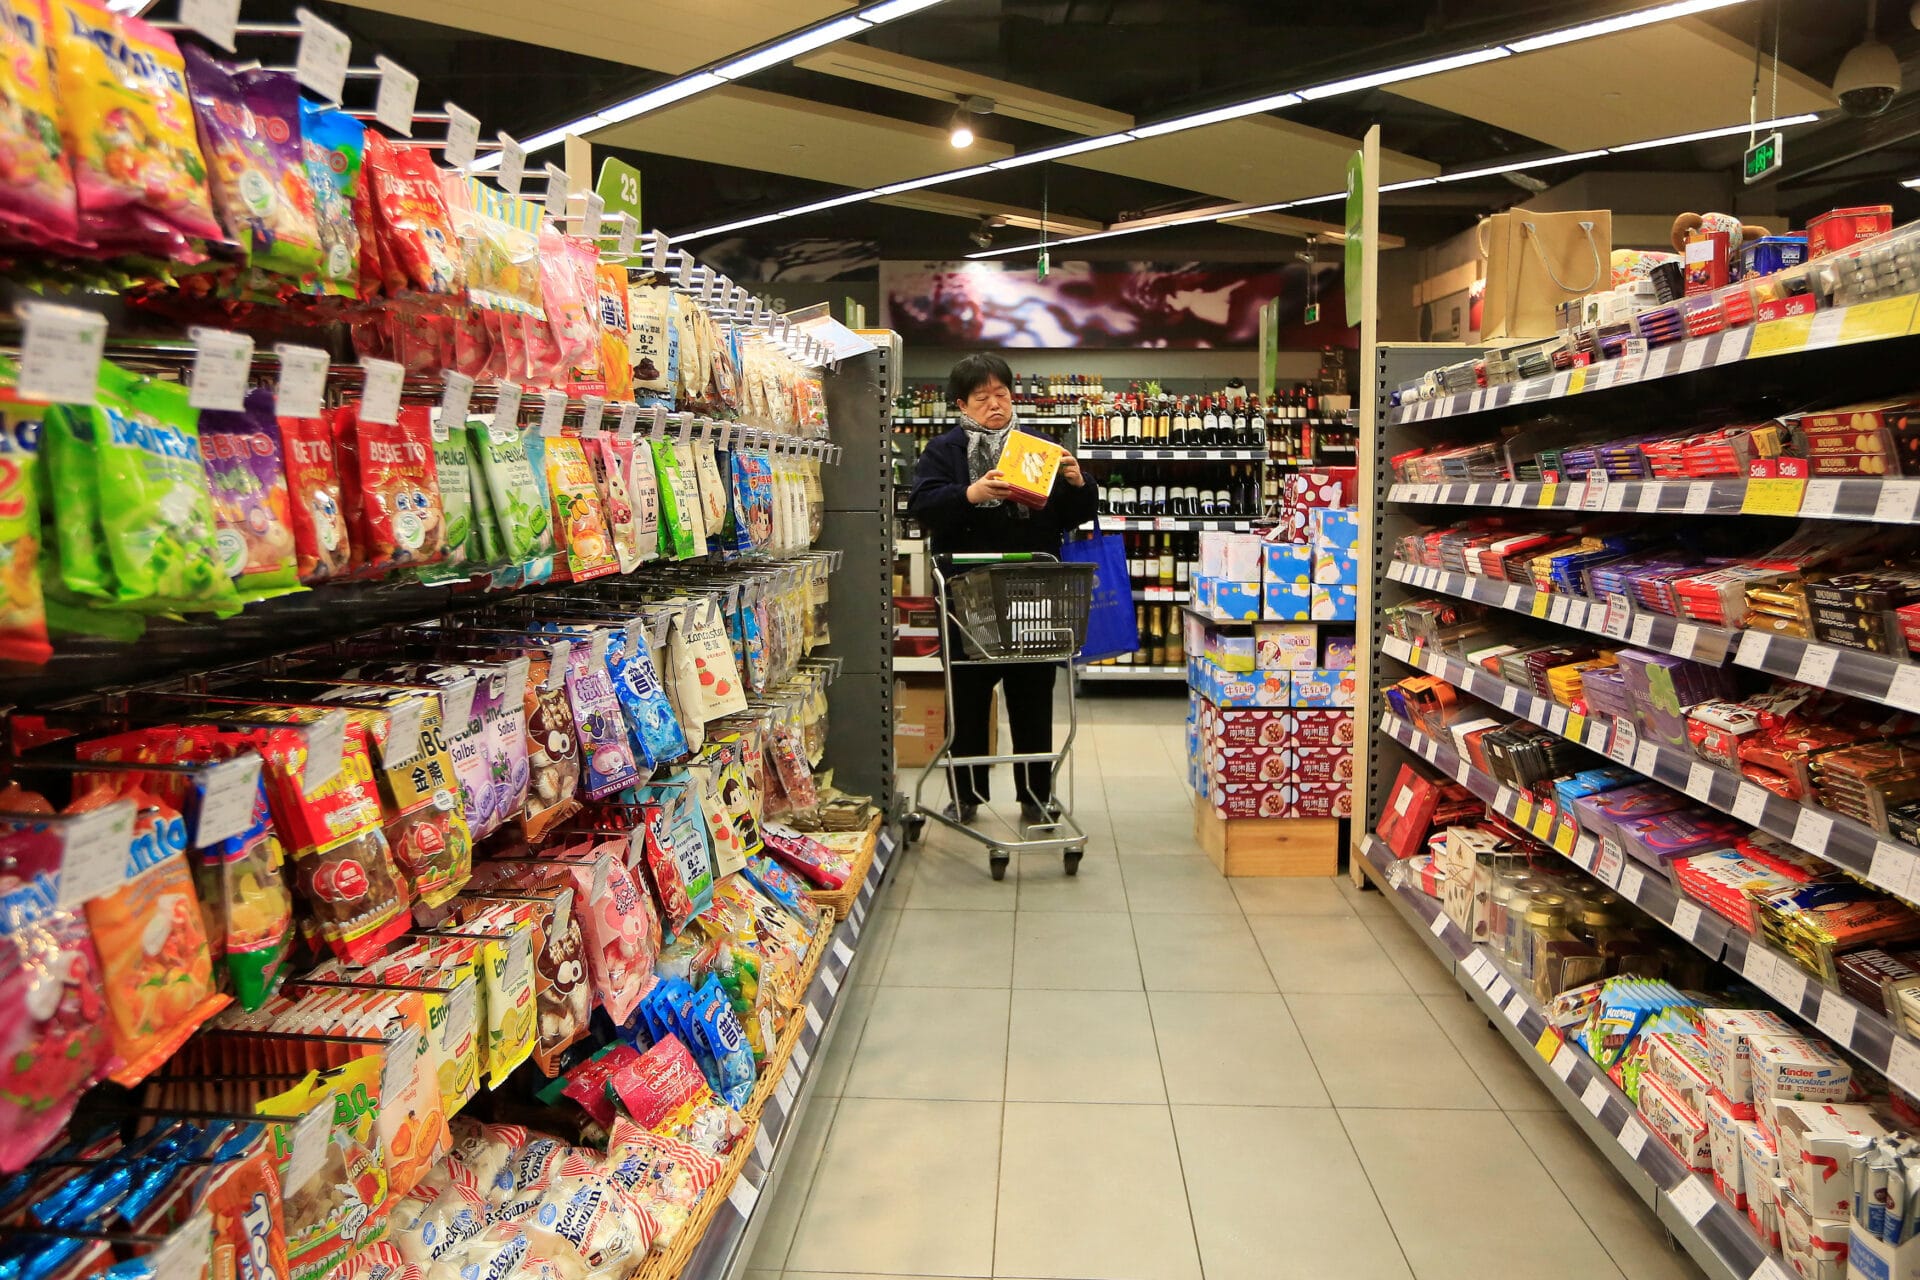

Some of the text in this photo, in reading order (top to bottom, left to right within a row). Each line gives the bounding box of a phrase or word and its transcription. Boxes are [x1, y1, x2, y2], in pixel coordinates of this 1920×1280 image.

[620, 173, 638, 205] 23
[1759, 302, 1804, 322] Sale Sale
[1751, 463, 1797, 477] Sale Sale
[1571, 702, 1581, 714] Sale
[603, 783, 622, 794] HELLO
[1542, 801, 1552, 814] Sale
[1779, 1066, 1814, 1078] kinder
[1777, 1075, 1849, 1086] Chocolate mini
